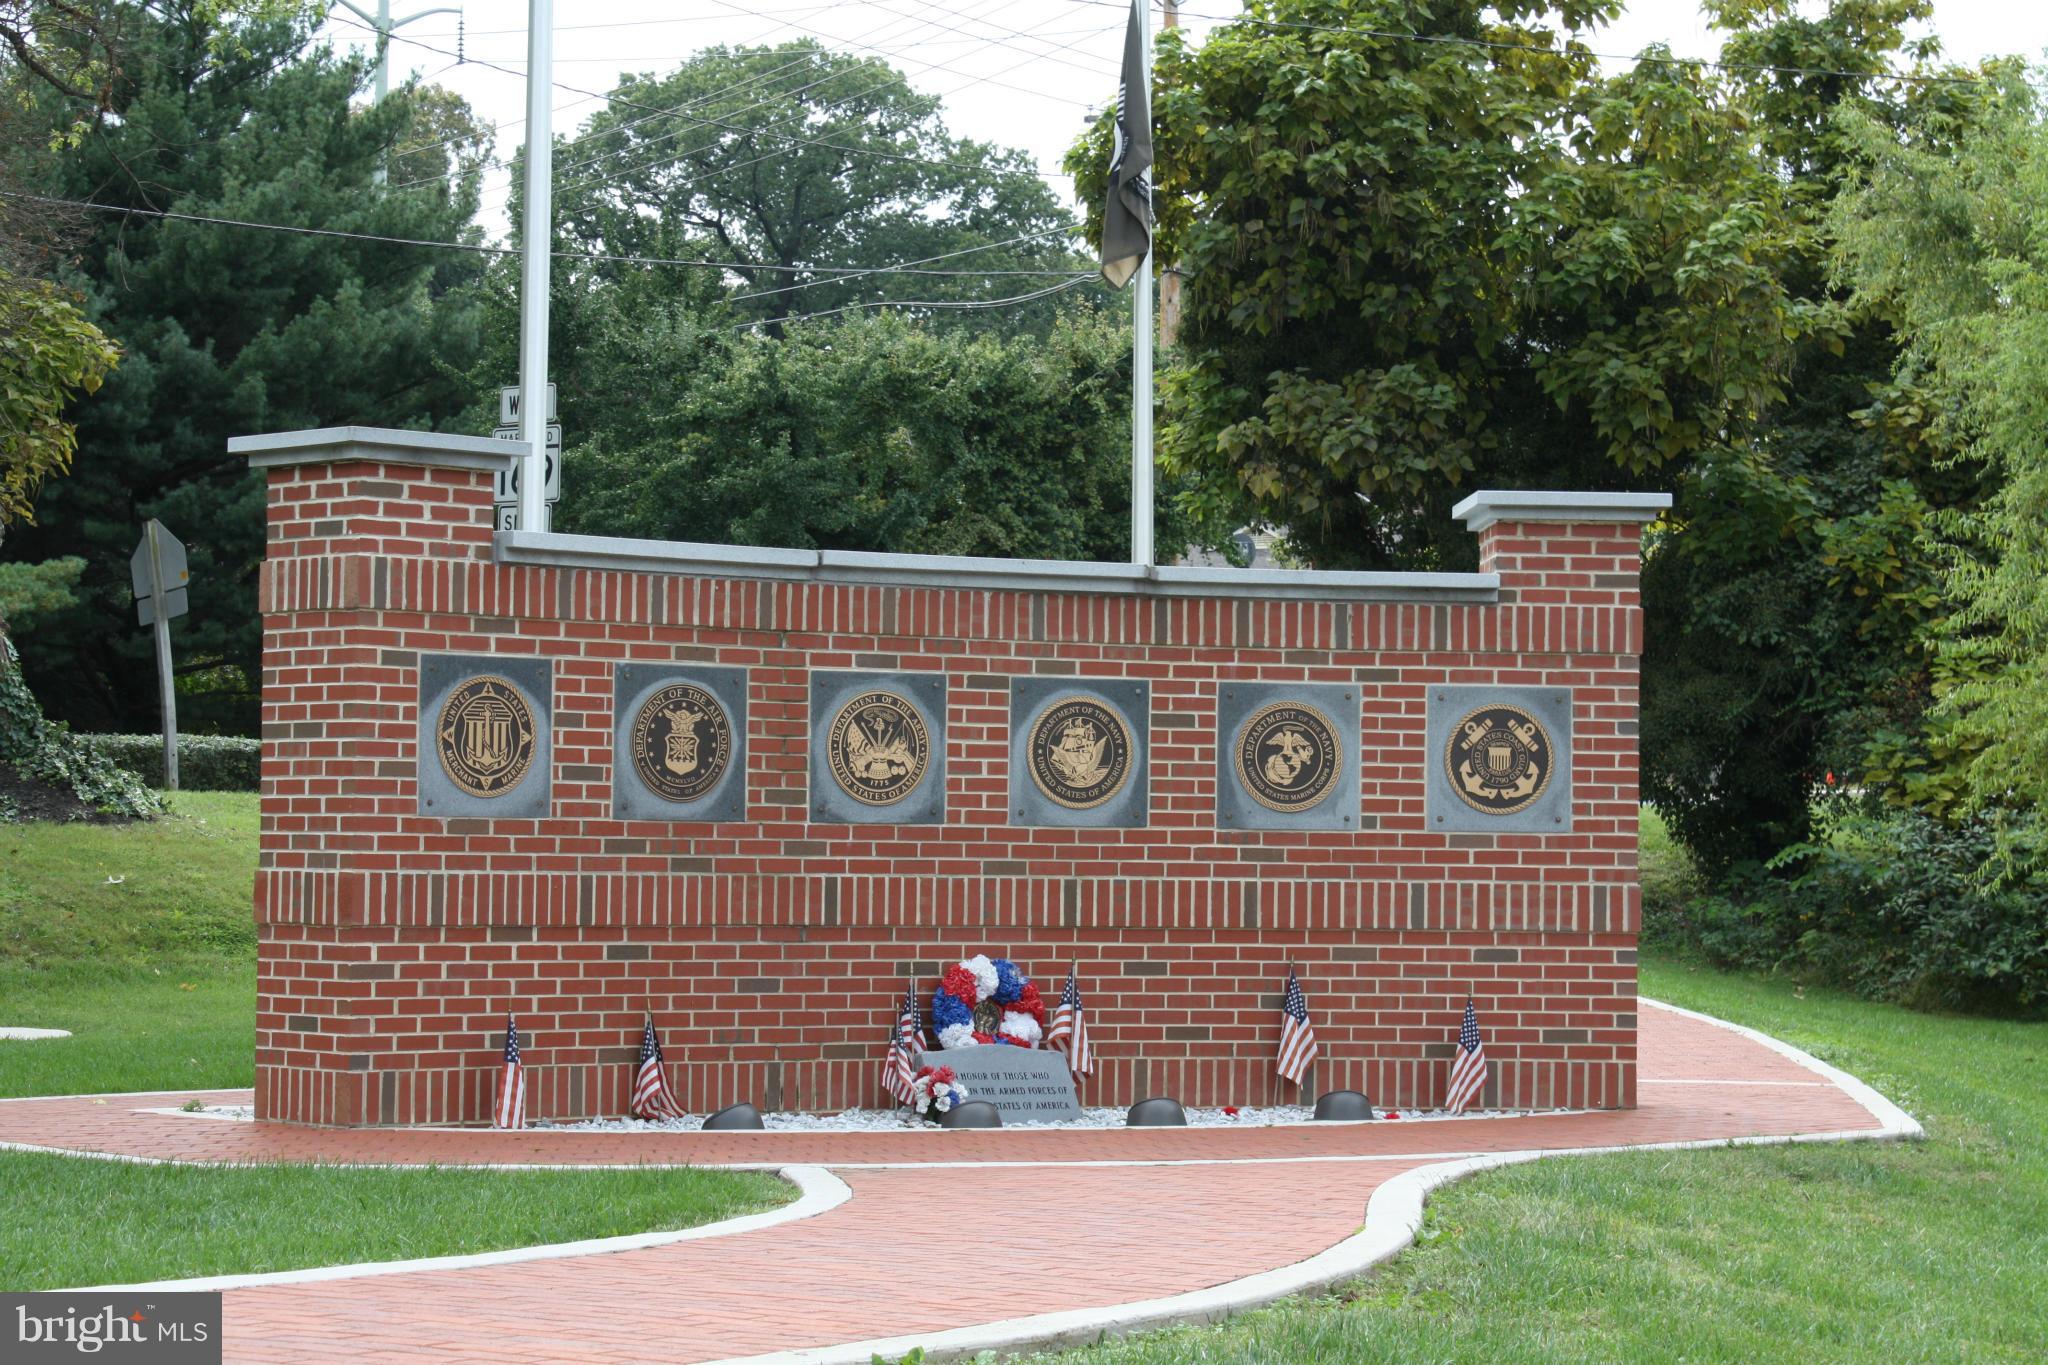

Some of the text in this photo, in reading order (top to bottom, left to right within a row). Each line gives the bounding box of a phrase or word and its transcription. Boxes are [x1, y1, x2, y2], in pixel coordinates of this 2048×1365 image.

[447, 690, 528, 722] UNITED STATES
[833, 696, 877, 740] DEPARTMENT
[882, 696, 893, 704] OF
[896, 700, 912, 716] THE
[912, 719, 926, 744] ARMY
[636, 689, 728, 766] DEPARTMENT OF THE AIR FORCE
[1038, 707, 1079, 744] DEPARTMENT
[1095, 710, 1110, 723] THE
[1108, 723, 1123, 744] NAVY
[1245, 711, 1296, 759] DEPARTMENT
[1309, 720, 1321, 733] THE
[1320, 732, 1333, 760] NAVY
[1478, 732, 1502, 750] STATES
[1503, 732, 1525, 753] COAST
[446, 750, 526, 786] MERCHANT MARINE
[832, 750, 926, 800] UNITED STATES OF AMERICA
[1038, 756, 1056, 787] UNITED
[1056, 786, 1087, 799] STATES
[1101, 756, 1124, 792] AMERICA
[1475, 752, 1490, 780] UNITED
[1509, 754, 1526, 778] GUARD
[1248, 767, 1330, 800] UNITED STATES MARINE CORPS
[960, 1072, 988, 1080] HONOR
[991, 1072, 1001, 1080] OF
[1003, 1071, 1029, 1080] THOSE
[1031, 1071, 1050, 1080] WHO
[981, 1087, 995, 1096] THE
[999, 1087, 1026, 1096] ARMED
[1028, 1087, 1056, 1095] FORCES
[994, 1101, 1071, 1110] STATES OF AMERICA
